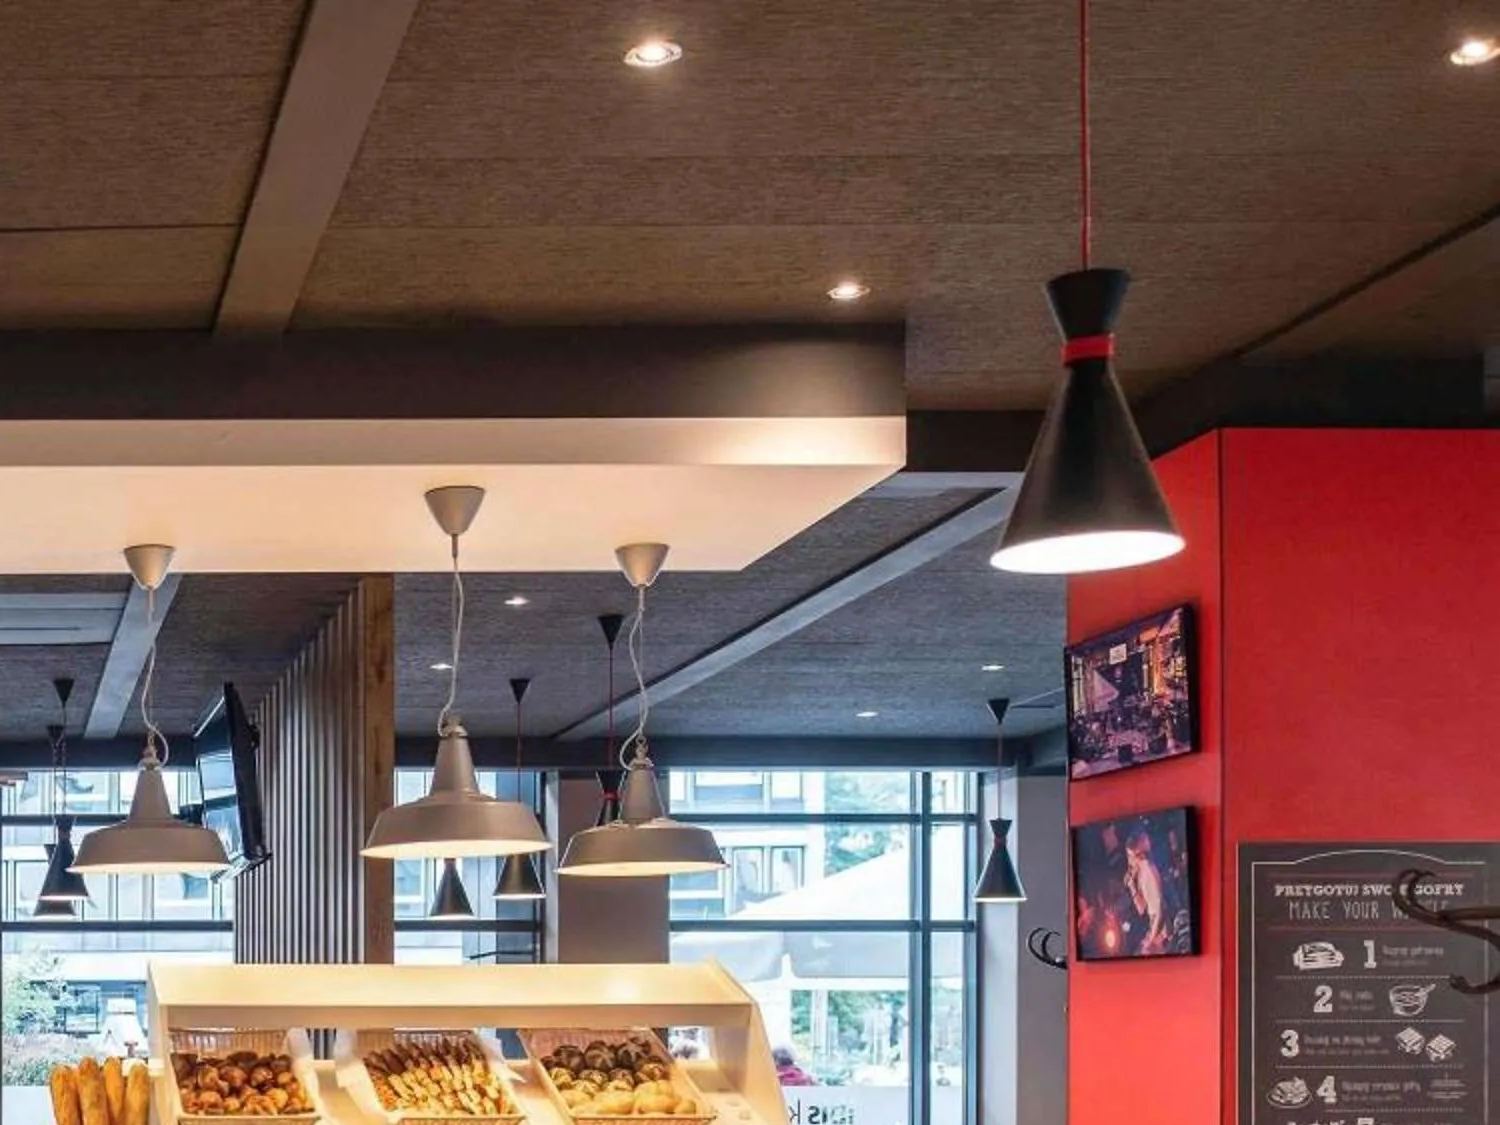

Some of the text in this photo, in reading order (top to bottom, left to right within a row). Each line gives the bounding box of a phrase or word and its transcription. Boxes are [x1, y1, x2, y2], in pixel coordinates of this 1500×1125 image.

[1288, 900, 1331, 920] MAKE
[1342, 900, 1379, 920] YOUR
[1363, 940, 1377, 968] 1
[1313, 985, 1333, 1013] 2
[1280, 1029, 1299, 1057] 3
[1316, 1076, 1336, 1104] 4
